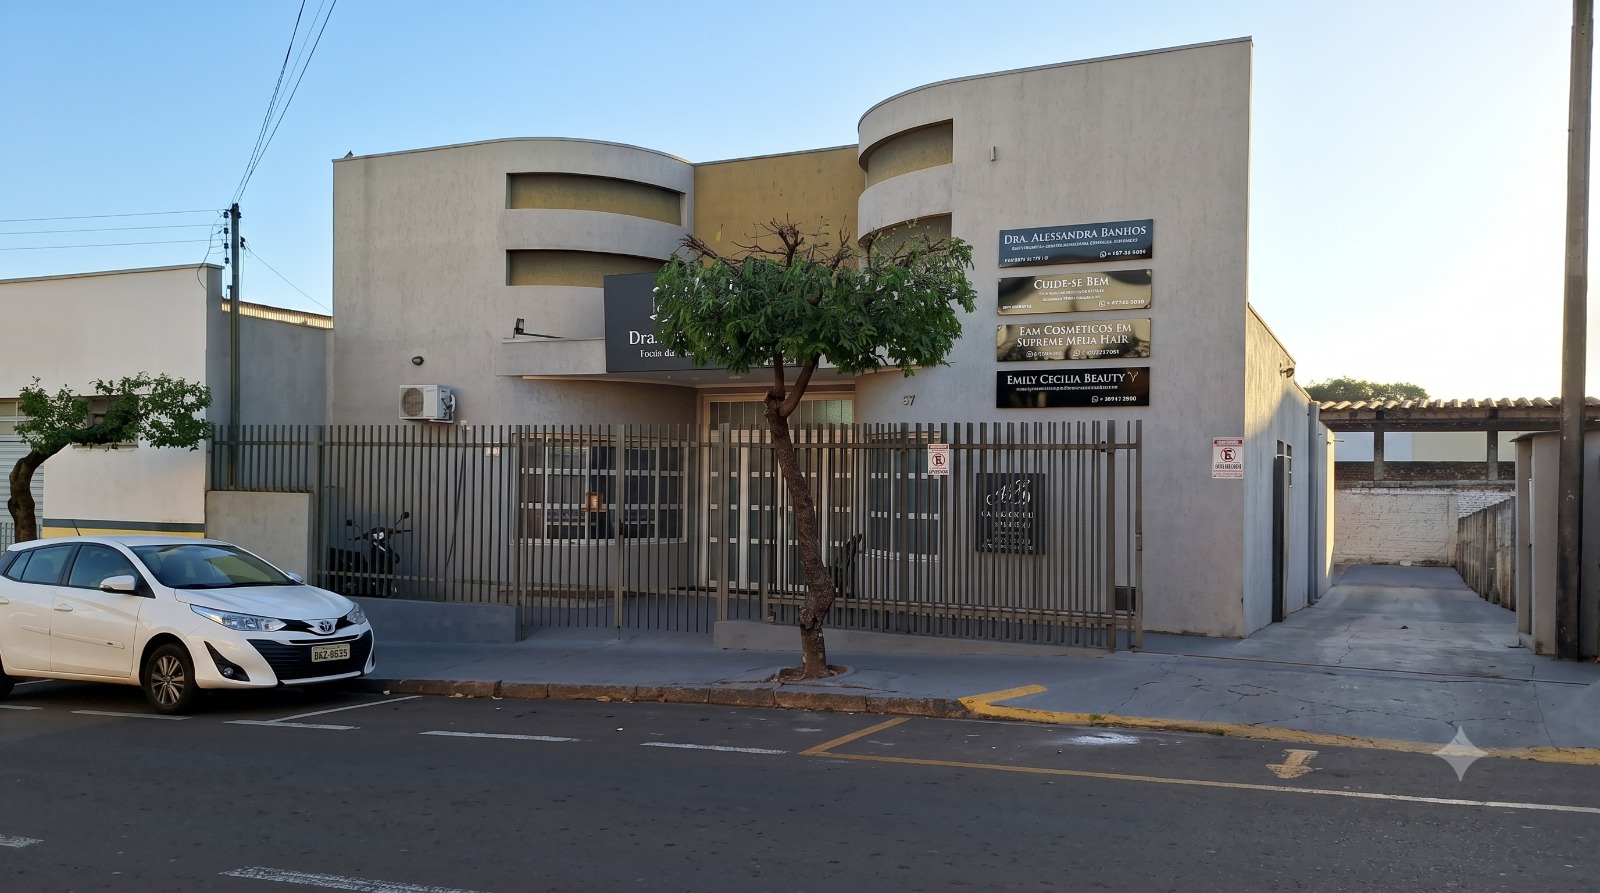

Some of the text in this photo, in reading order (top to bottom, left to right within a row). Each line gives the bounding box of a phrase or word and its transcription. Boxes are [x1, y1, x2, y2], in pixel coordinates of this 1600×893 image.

[1004, 234, 1028, 244] DRA.
[1032, 229, 1098, 242] ALESSANDRA
[1101, 226, 1146, 238] BANHOS
[1034, 276, 1110, 290] CUIDE-SE BEM
[1020, 324, 1132, 336] EAM COSMETICOS EM
[628, 330, 658, 345] Dra.
[1017, 337, 1063, 347] SUPREME
[1100, 334, 1130, 344] HAIR
[1007, 374, 1126, 385] EMILY CECILIA BEAUTY
